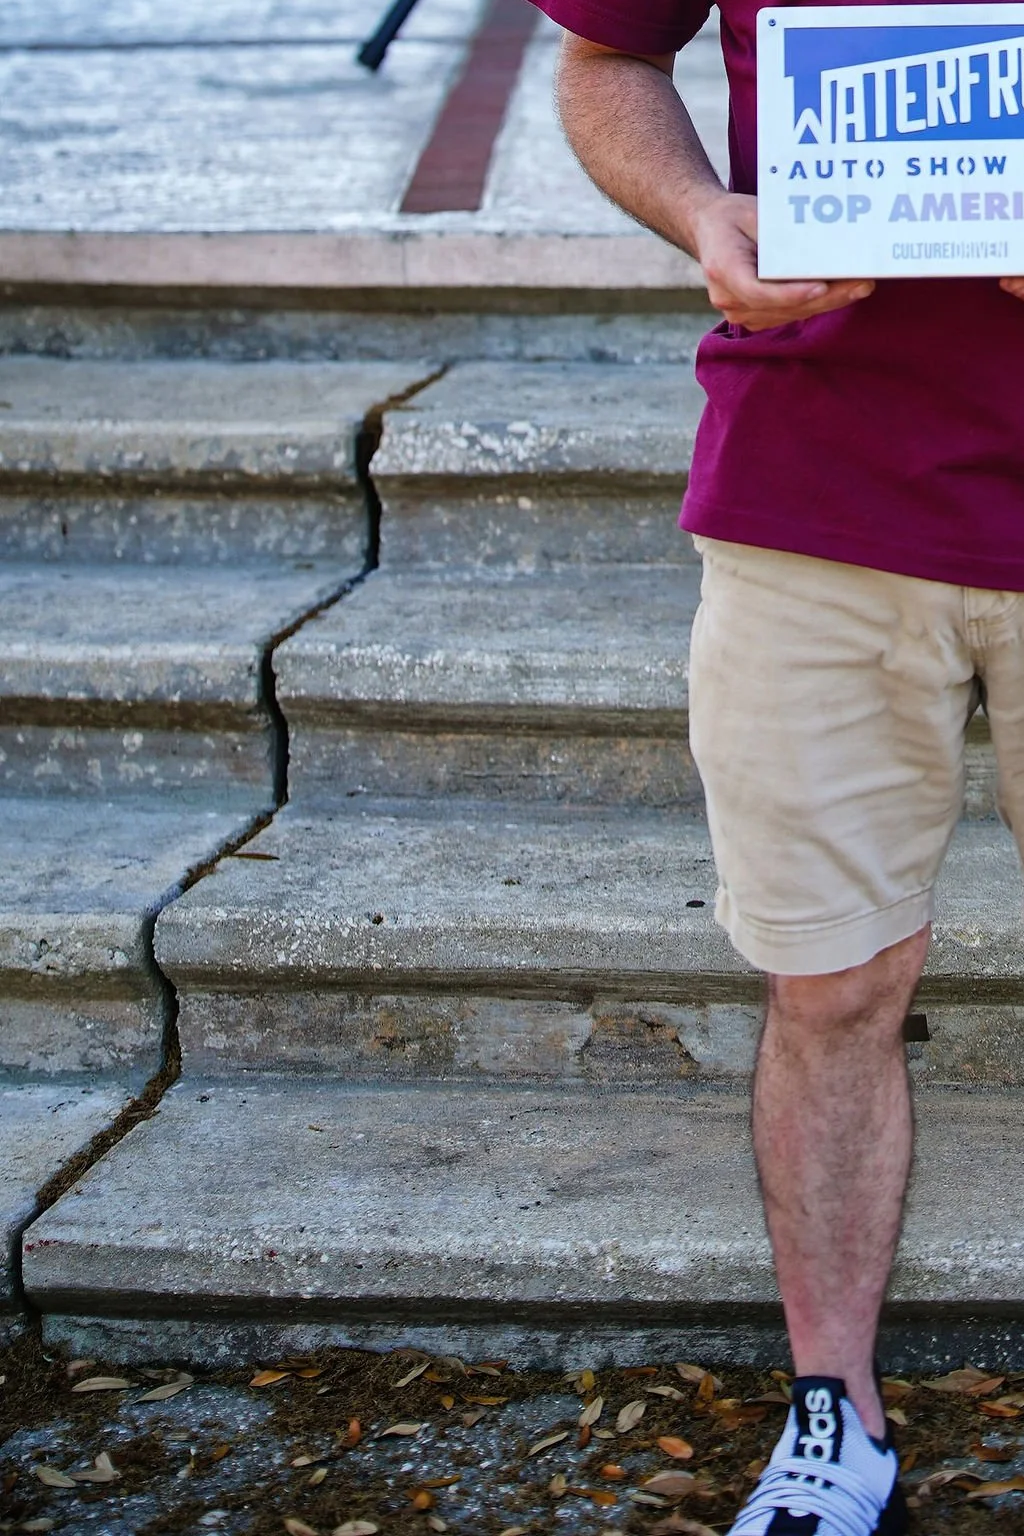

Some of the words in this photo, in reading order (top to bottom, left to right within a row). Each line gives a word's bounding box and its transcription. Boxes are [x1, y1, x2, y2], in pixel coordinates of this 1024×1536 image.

[788, 159, 885, 180] AUTO
[906, 156, 1007, 177] SHOW
[788, 194, 872, 224] TOP
